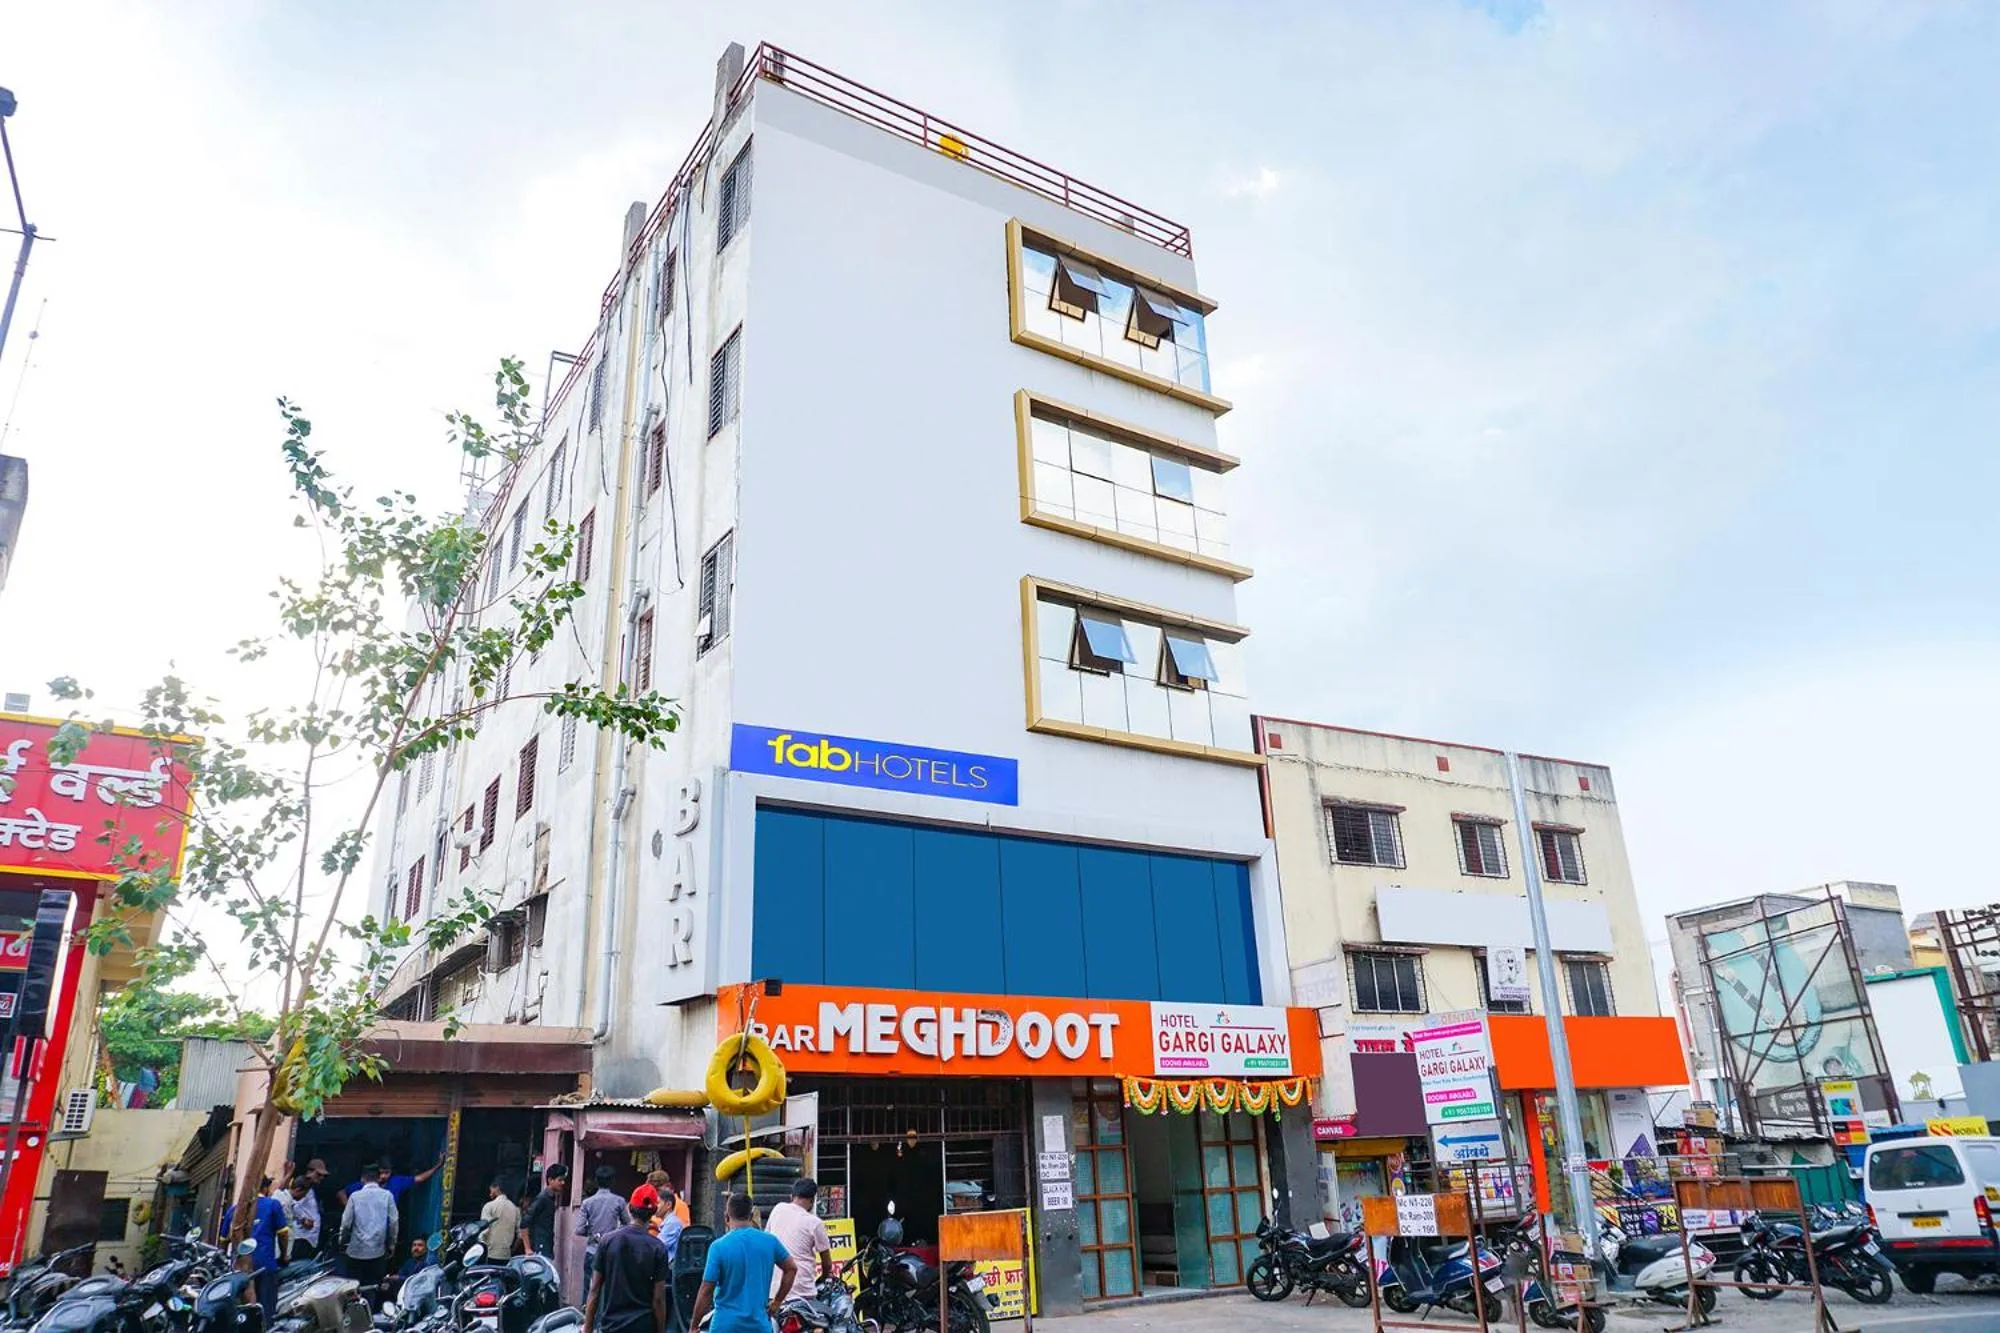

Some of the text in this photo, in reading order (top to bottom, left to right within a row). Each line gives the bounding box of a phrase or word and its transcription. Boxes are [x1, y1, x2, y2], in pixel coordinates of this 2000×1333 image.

[666, 776, 701, 969] BAR
[752, 1001, 1120, 1062] BAR MEGHDOOT
[1160, 1014, 1198, 1028] HOTEL
[1159, 1031, 1286, 1054] GARGI GALAXY
[1419, 1047, 1445, 1060] HOTEL
[1420, 1056, 1486, 1077] GARGI GALAXY
